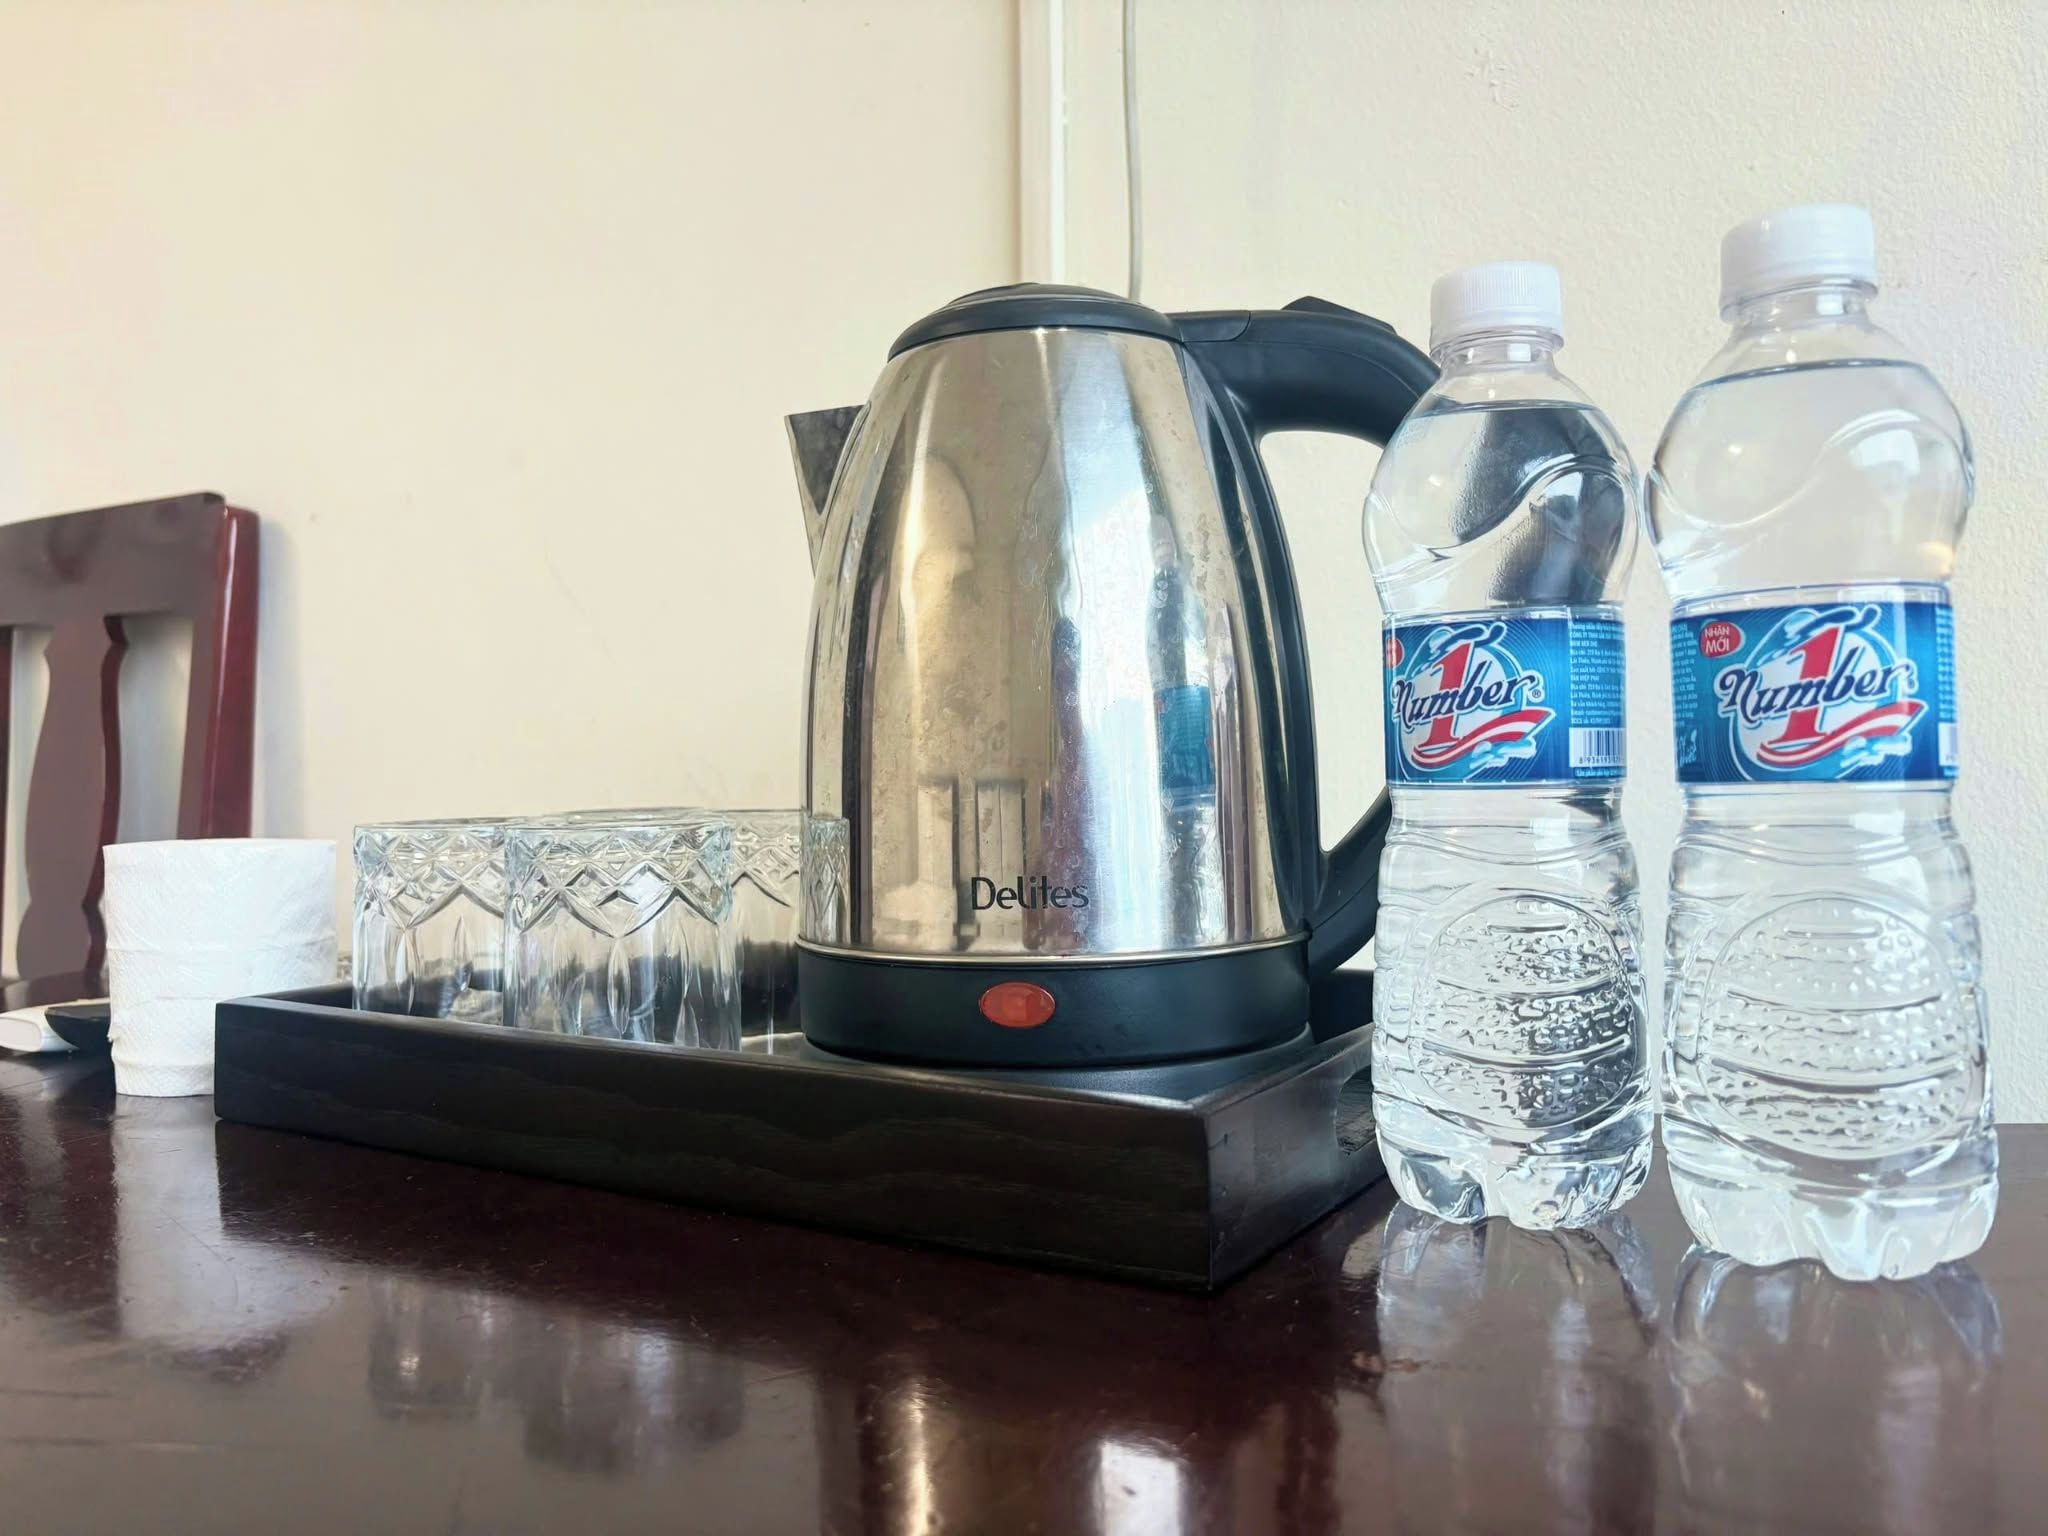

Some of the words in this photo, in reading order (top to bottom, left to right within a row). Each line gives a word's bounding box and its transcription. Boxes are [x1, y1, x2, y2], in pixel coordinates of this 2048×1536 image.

[1395, 661, 1535, 728] Number
[1415, 643, 1471, 747] 1
[1719, 646, 1911, 723] Number
[1767, 627, 1841, 744] 1
[970, 876, 1089, 910] Delites
